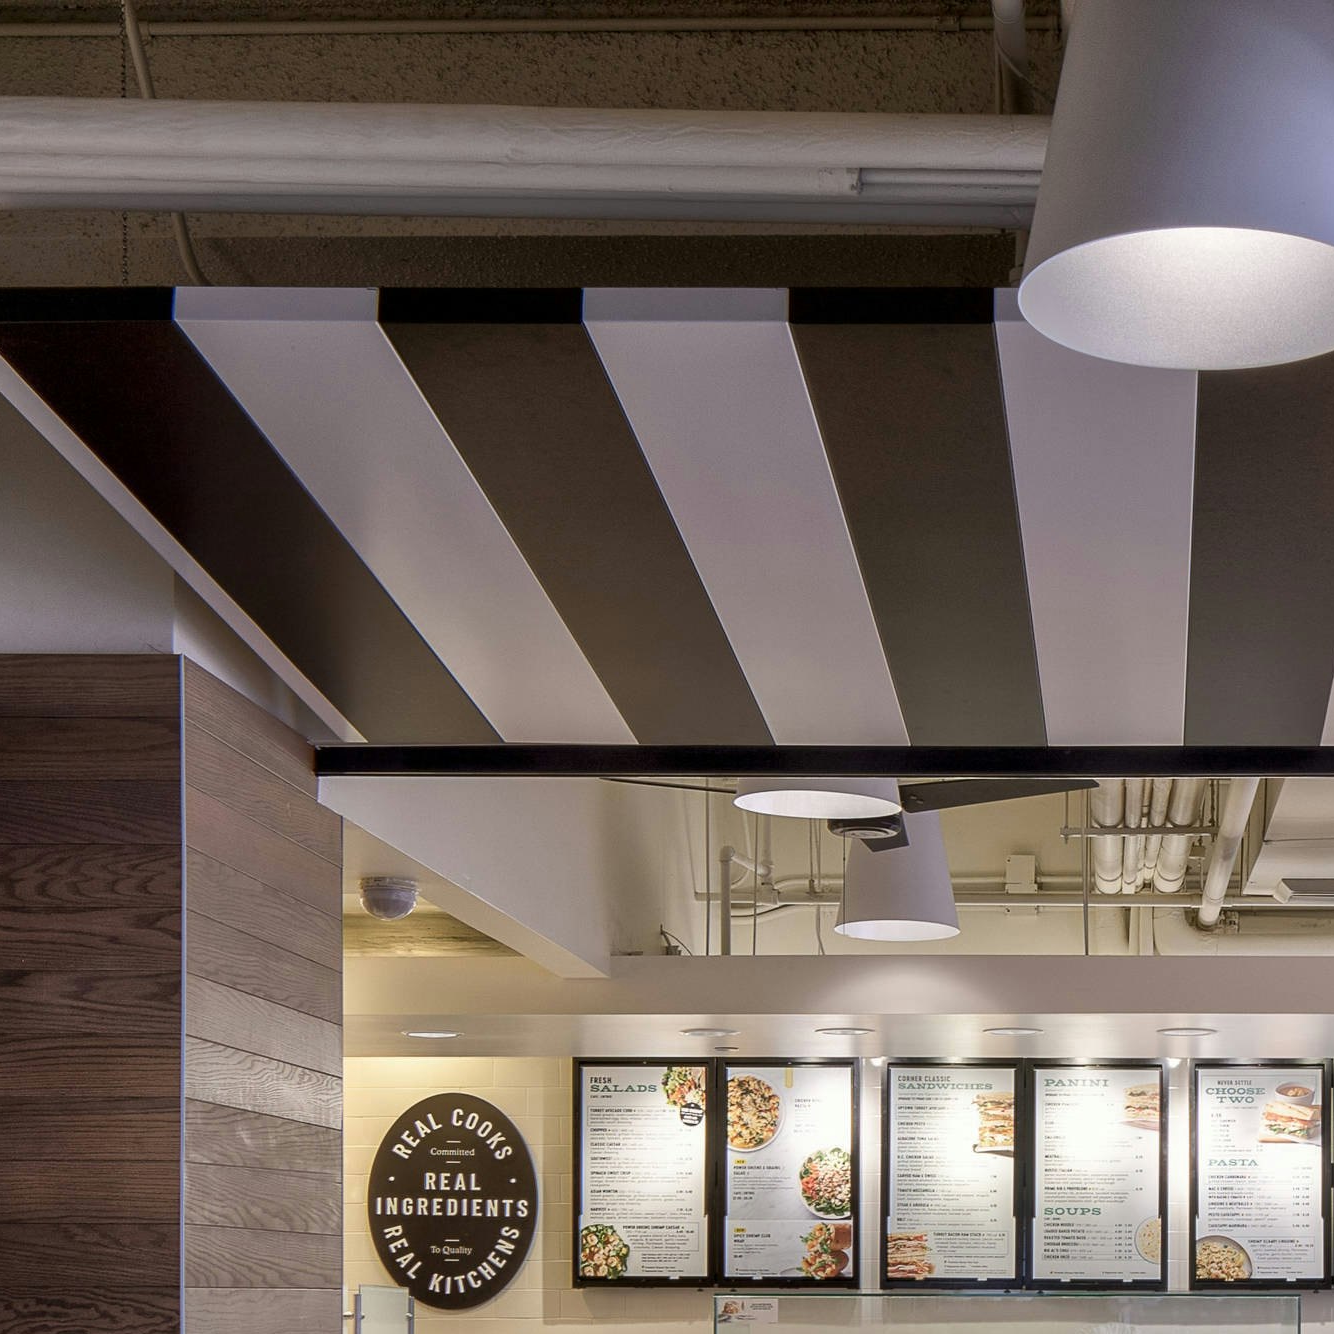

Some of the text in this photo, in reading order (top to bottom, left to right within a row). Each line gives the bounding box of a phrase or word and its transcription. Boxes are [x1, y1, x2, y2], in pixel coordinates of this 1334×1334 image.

[1044, 1079, 1109, 1087] PANINI
[392, 1108, 513, 1160] REAL COOKS
[430, 1147, 475, 1156] Committed
[1208, 1159, 1259, 1167] PASTA
[424, 1172, 482, 1191] REAL
[375, 1197, 529, 1218] INGREDIENTS
[1044, 1207, 1102, 1216] SOUPS
[430, 1245, 473, 1256] To Quality
[383, 1225, 520, 1294] REAL KITCHENS
